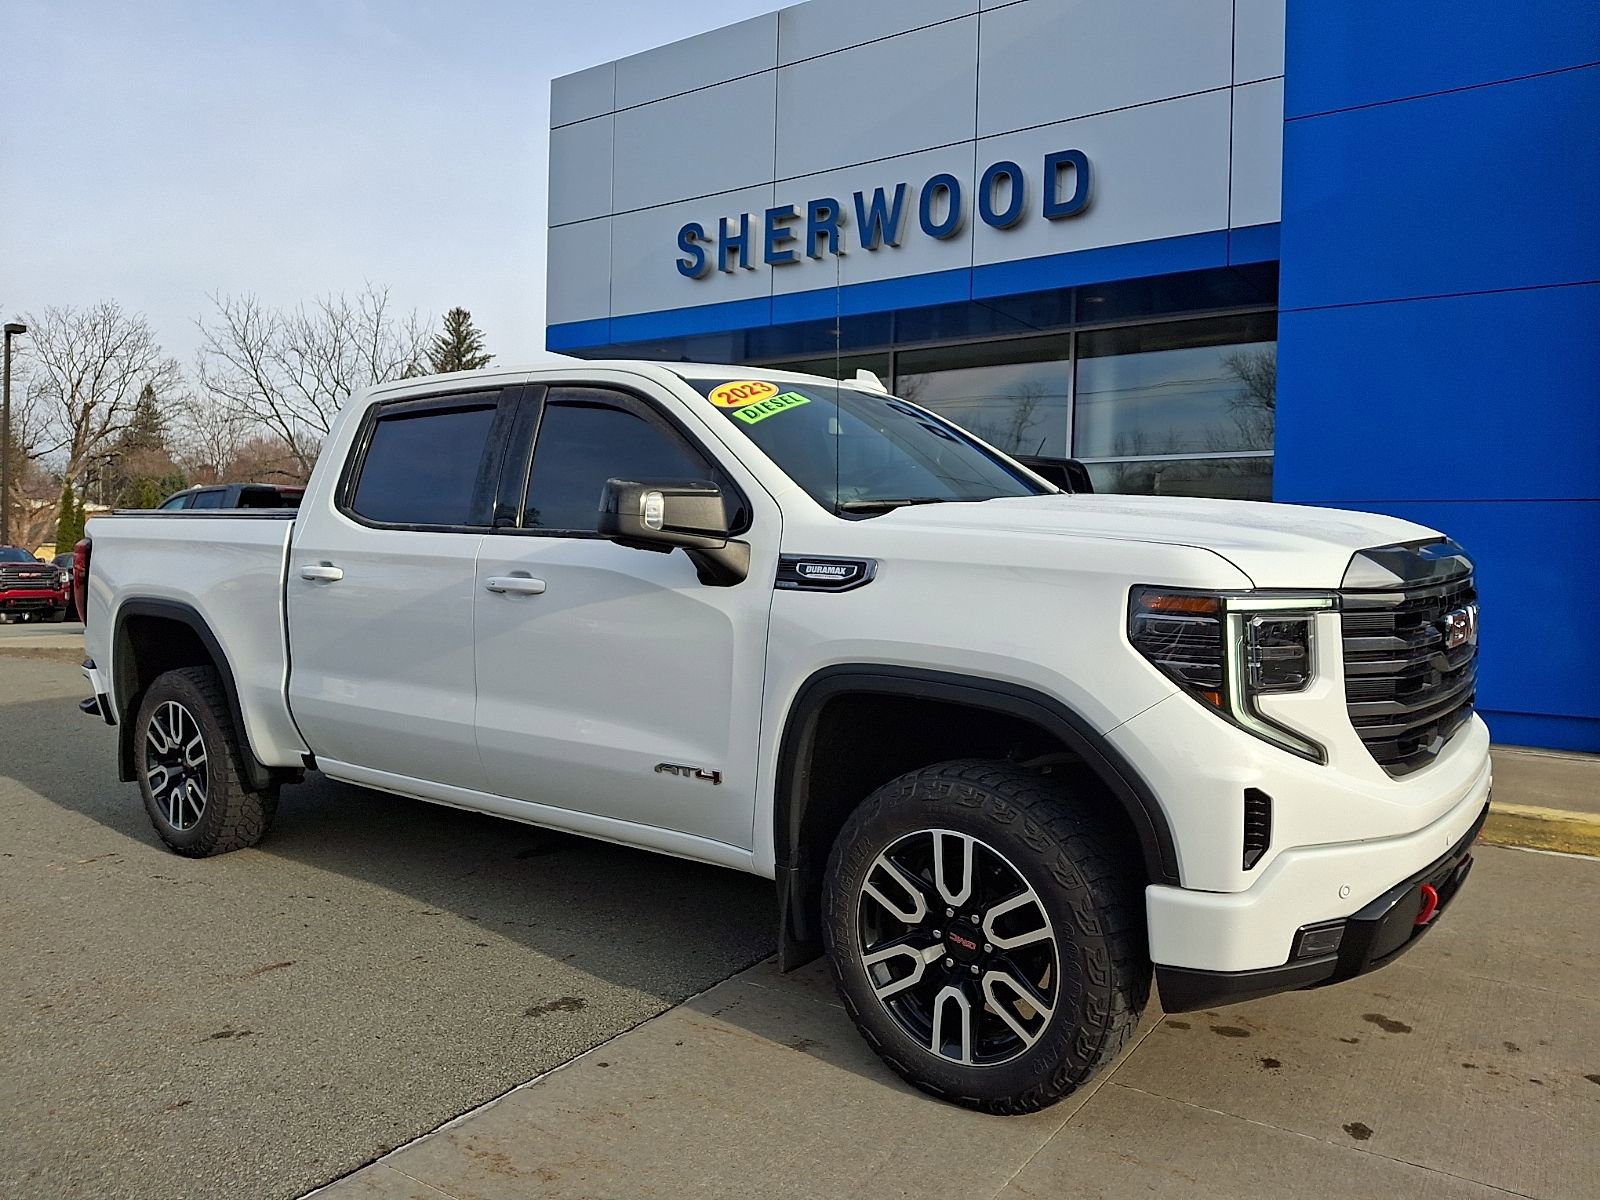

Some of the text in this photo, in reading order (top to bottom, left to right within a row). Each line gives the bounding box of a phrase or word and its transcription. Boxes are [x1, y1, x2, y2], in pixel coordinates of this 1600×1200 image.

[676, 148, 1093, 279] SHERWOOD
[718, 381, 771, 405] 2023
[741, 394, 803, 419] DIESEL
[805, 565, 847, 575] DURAMAX
[654, 762, 722, 786] AT4
